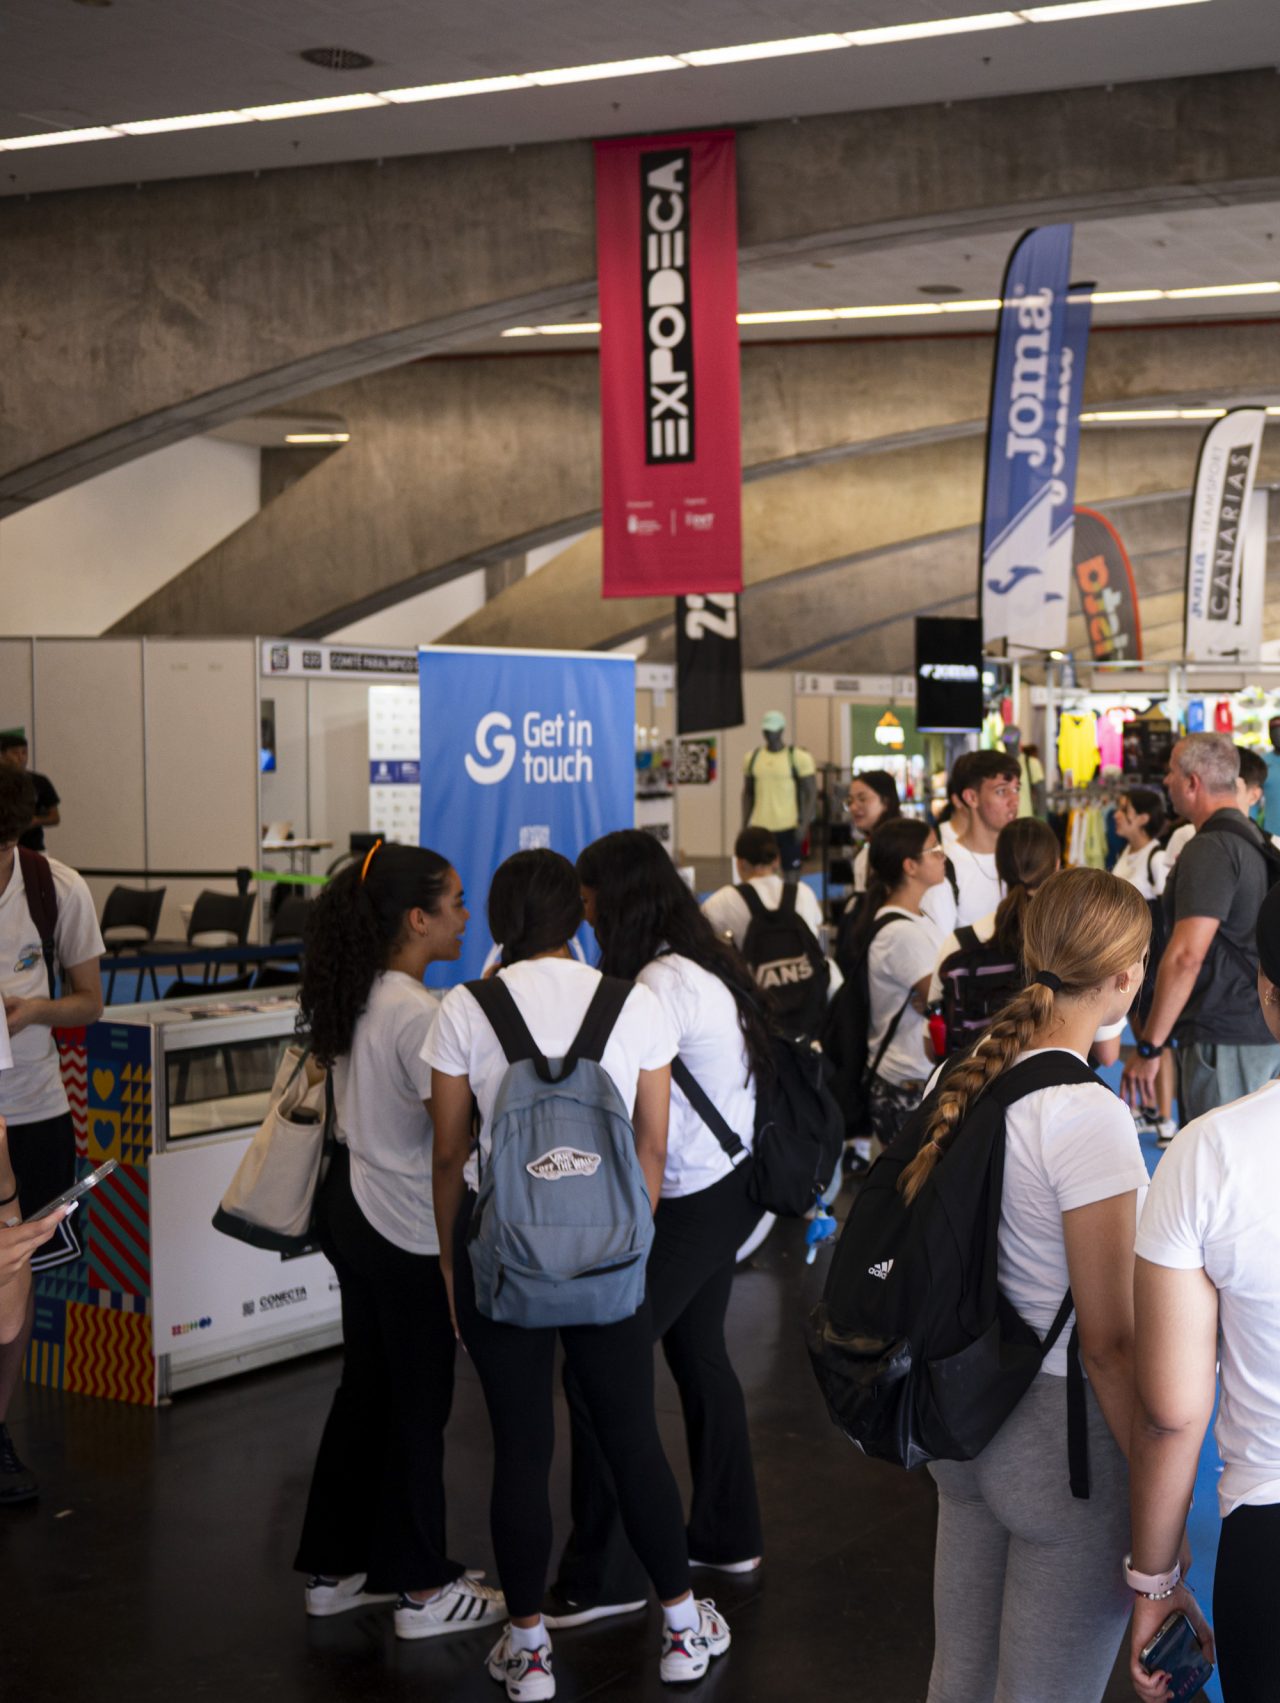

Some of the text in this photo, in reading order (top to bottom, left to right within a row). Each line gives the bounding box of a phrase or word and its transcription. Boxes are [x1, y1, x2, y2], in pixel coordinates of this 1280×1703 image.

[646, 157, 690, 459] EXPODECA
[1006, 286, 1054, 468] Joma
[1211, 453, 1249, 616] CANARIAS
[522, 748, 593, 784] touch
[523, 709, 592, 747] Get in
[259, 1286, 307, 1307] CONECTA
